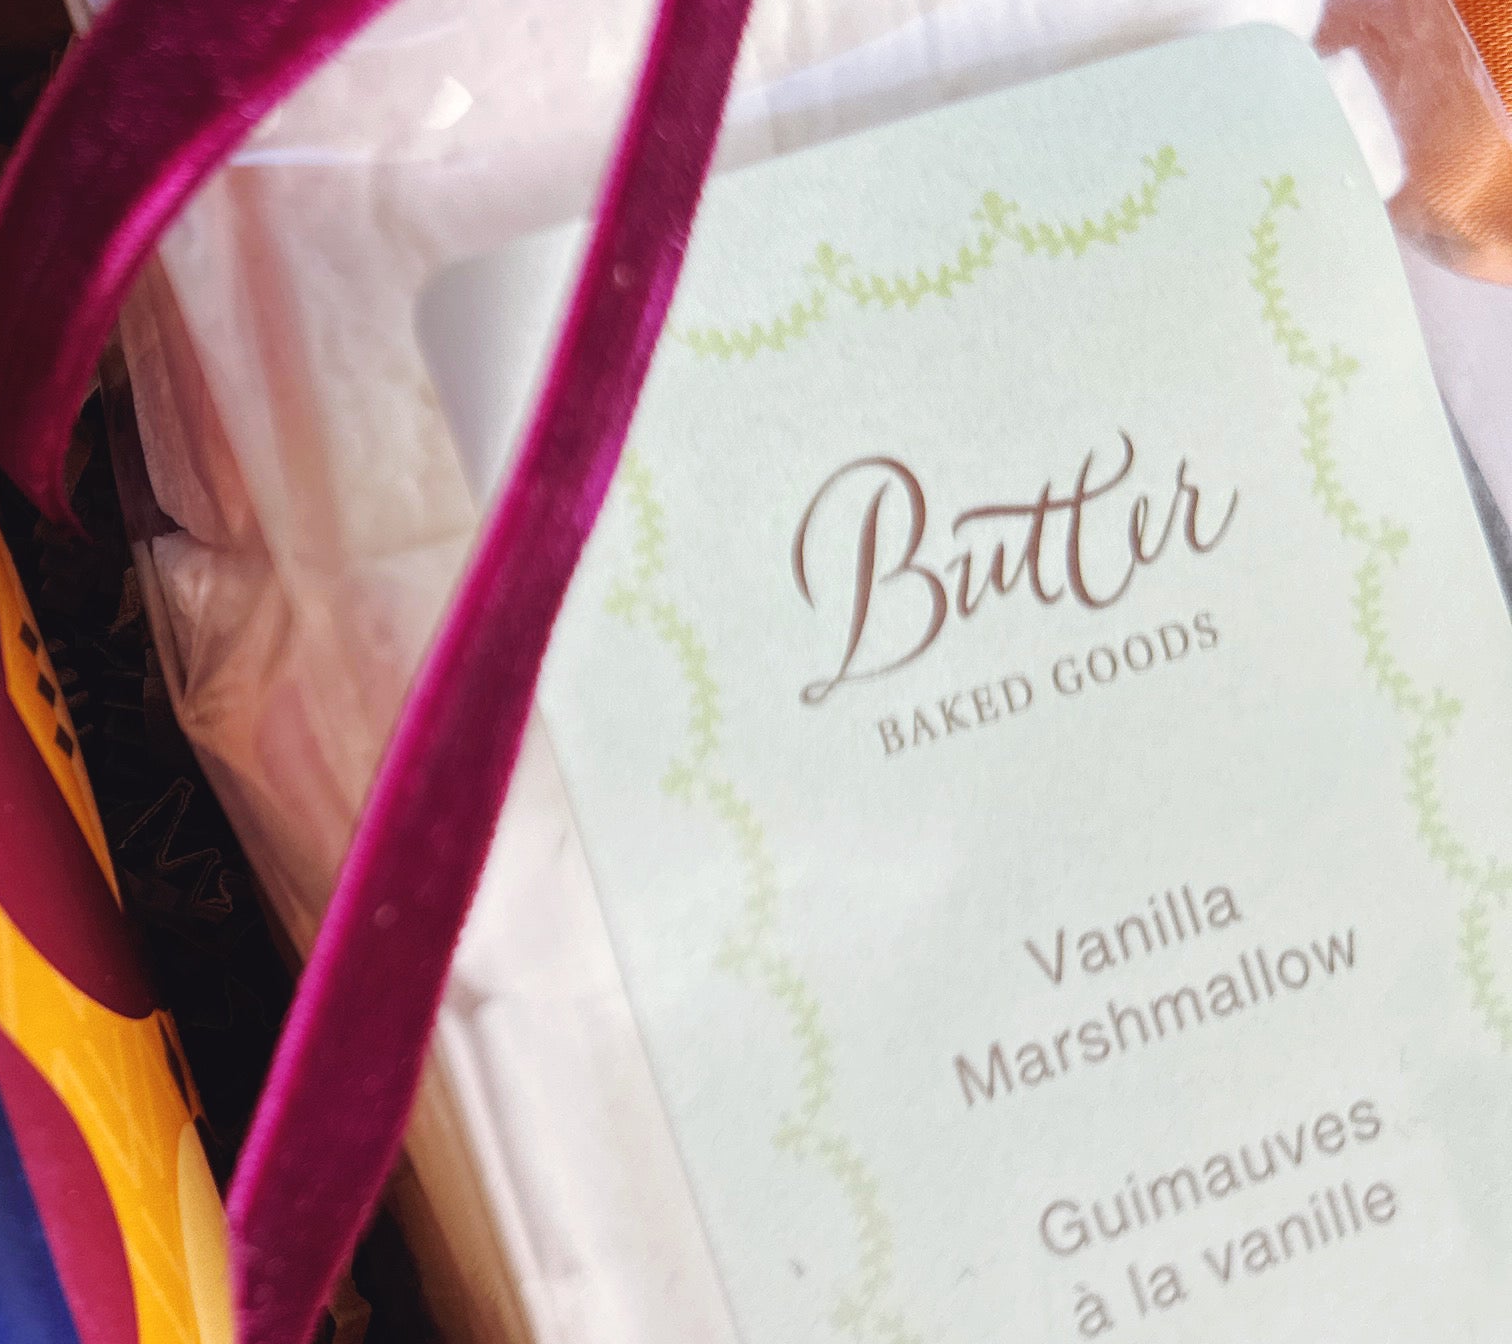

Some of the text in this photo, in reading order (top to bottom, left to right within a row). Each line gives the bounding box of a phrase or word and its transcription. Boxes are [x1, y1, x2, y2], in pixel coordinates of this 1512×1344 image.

[791, 430, 1239, 706] Butter
[876, 609, 1221, 757] BAKED GOODS
[1024, 884, 1242, 986] Vanilla
[952, 927, 1357, 1107] Marshmallow
[1038, 1098, 1383, 1258] Guimauves
[1072, 1178, 1399, 1340] à la vanille
